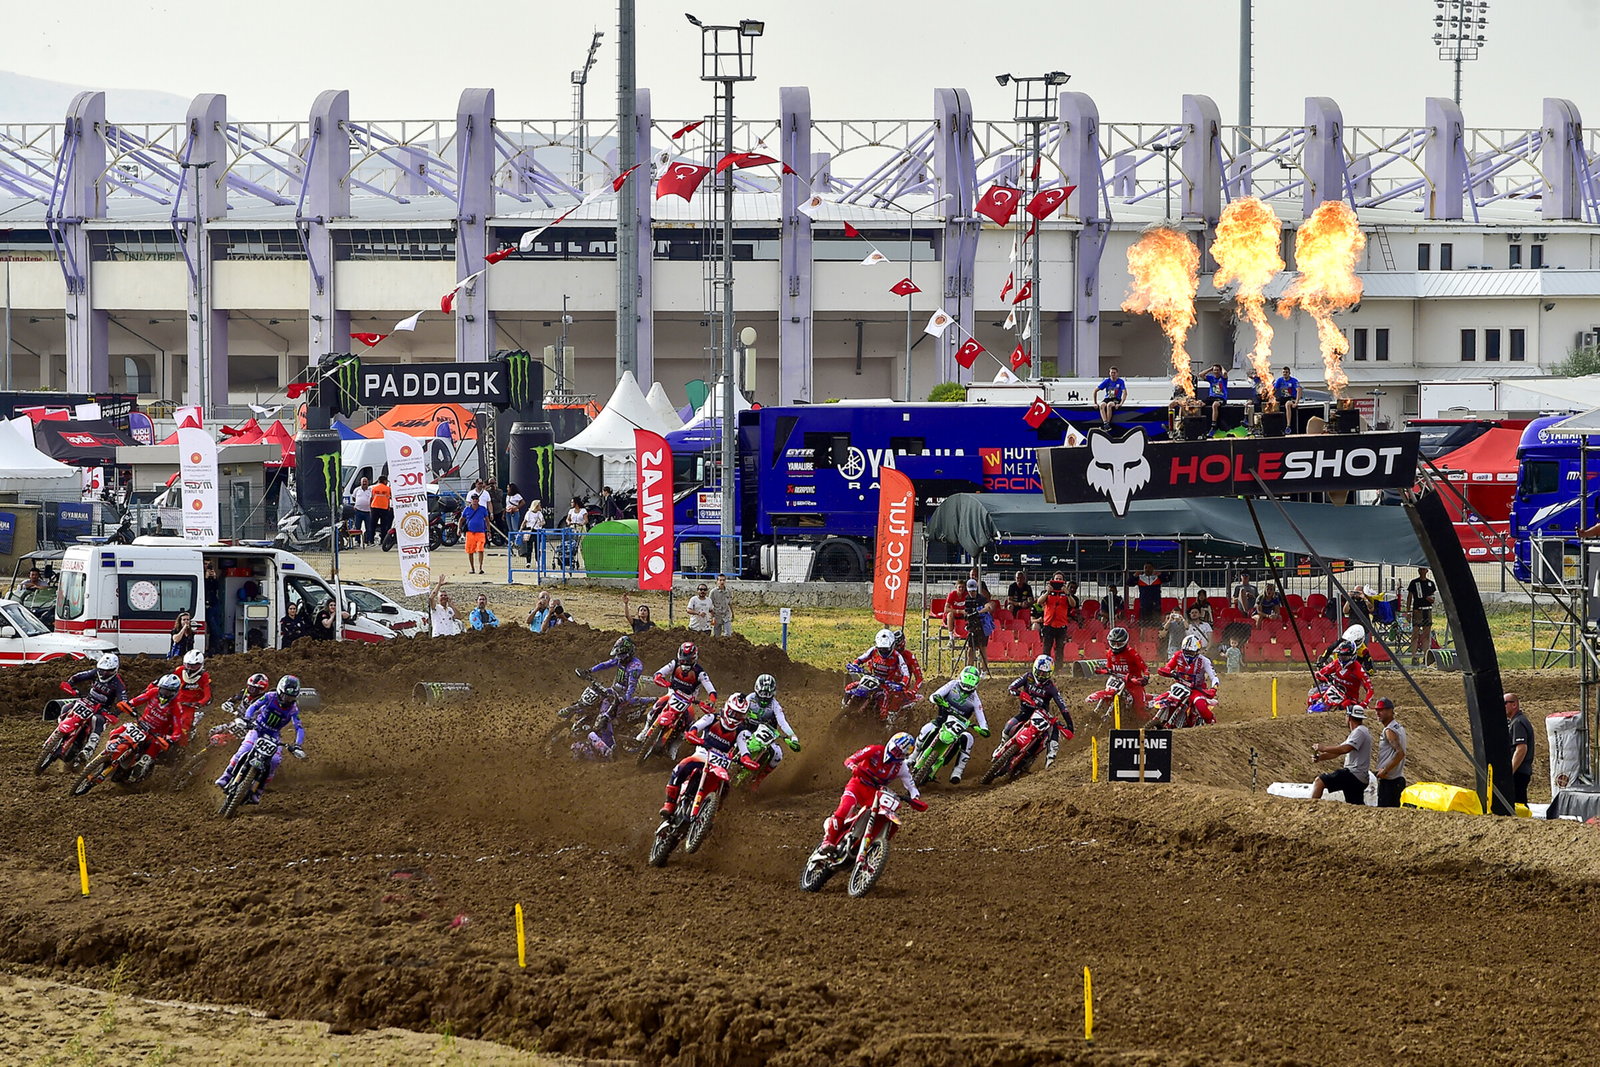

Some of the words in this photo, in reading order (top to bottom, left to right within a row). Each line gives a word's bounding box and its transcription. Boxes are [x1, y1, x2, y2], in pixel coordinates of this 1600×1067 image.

[365, 371, 500, 398] PADDOCK
[788, 462, 814, 470] YAMALUBE
[1168, 446, 1403, 485] HOLESHOT
[68, 512, 88, 520] YAMAHA
[74, 703, 93, 719] 189
[670, 698, 686, 711] 70
[944, 720, 966, 734] 43
[1031, 717, 1049, 731] 41
[126, 725, 145, 742] 303
[708, 731, 731, 746] HONDA
[756, 729, 774, 743] 3
[256, 739, 277, 755] 959
[710, 754, 729, 768] 243
[879, 793, 900, 812] 61
